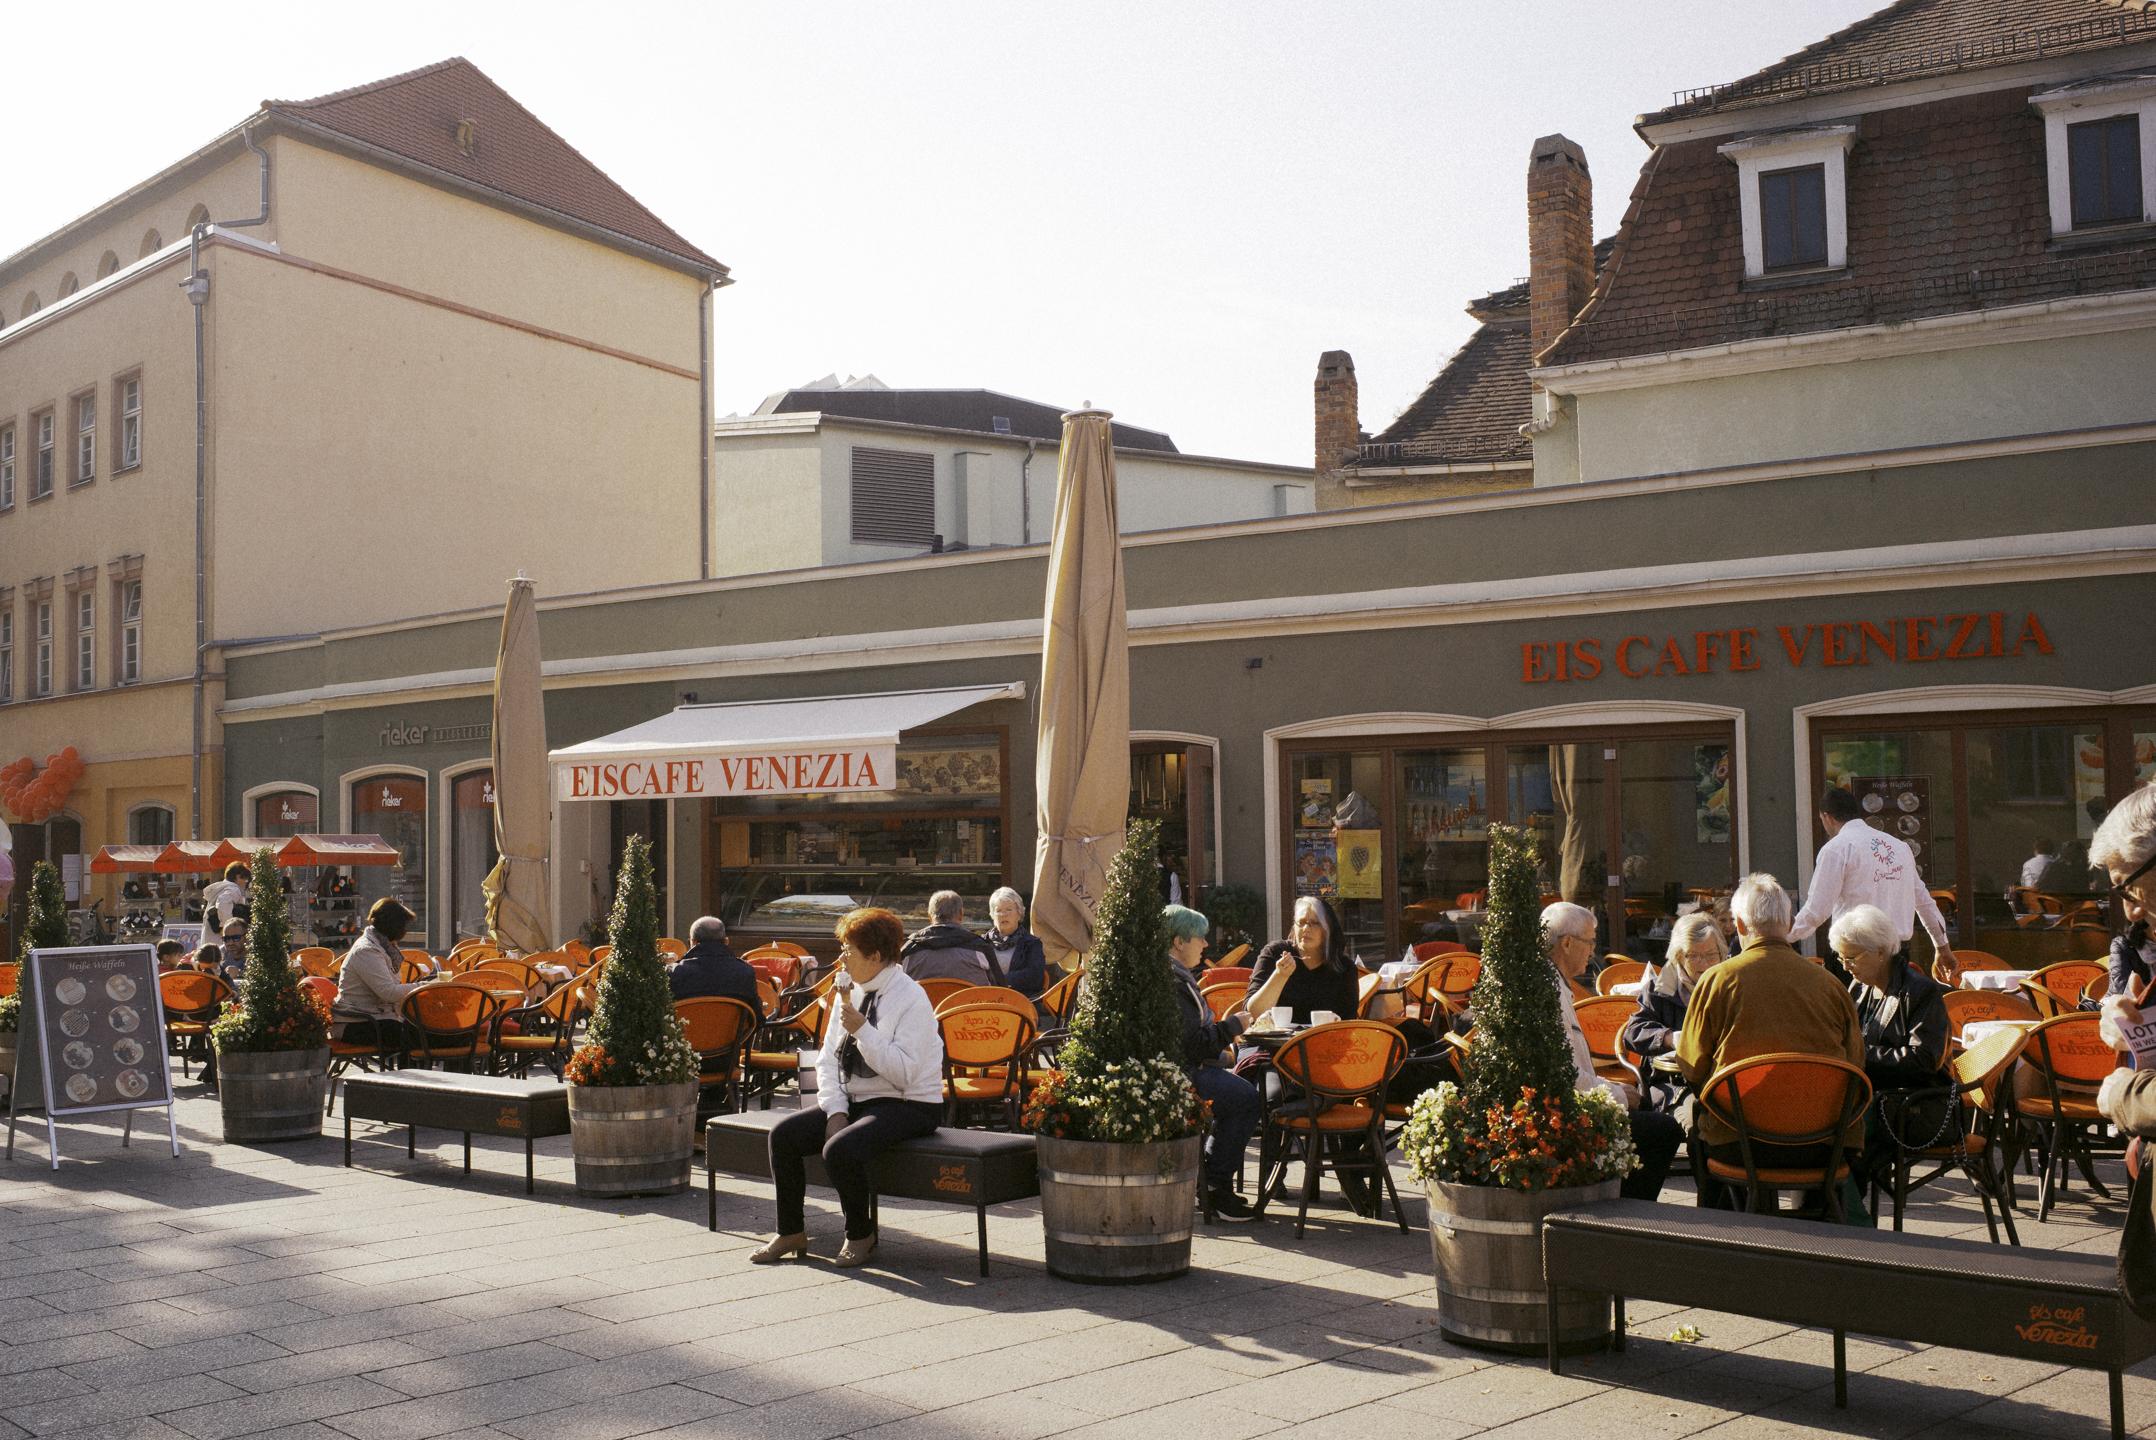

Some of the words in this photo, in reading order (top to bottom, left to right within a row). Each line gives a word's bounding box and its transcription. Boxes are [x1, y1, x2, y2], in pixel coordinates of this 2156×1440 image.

[1520, 637, 1602, 683] EIS
[1615, 626, 1762, 679] CAFE
[1776, 611, 2055, 668] VENEZIA
[379, 720, 428, 747] rieker
[570, 760, 704, 797] EISCAFE
[719, 752, 879, 792] VENEZIA
[281, 810, 299, 820] rieker
[382, 796, 402, 807] rieker
[2015, 1321, 2098, 1349] Venezia
